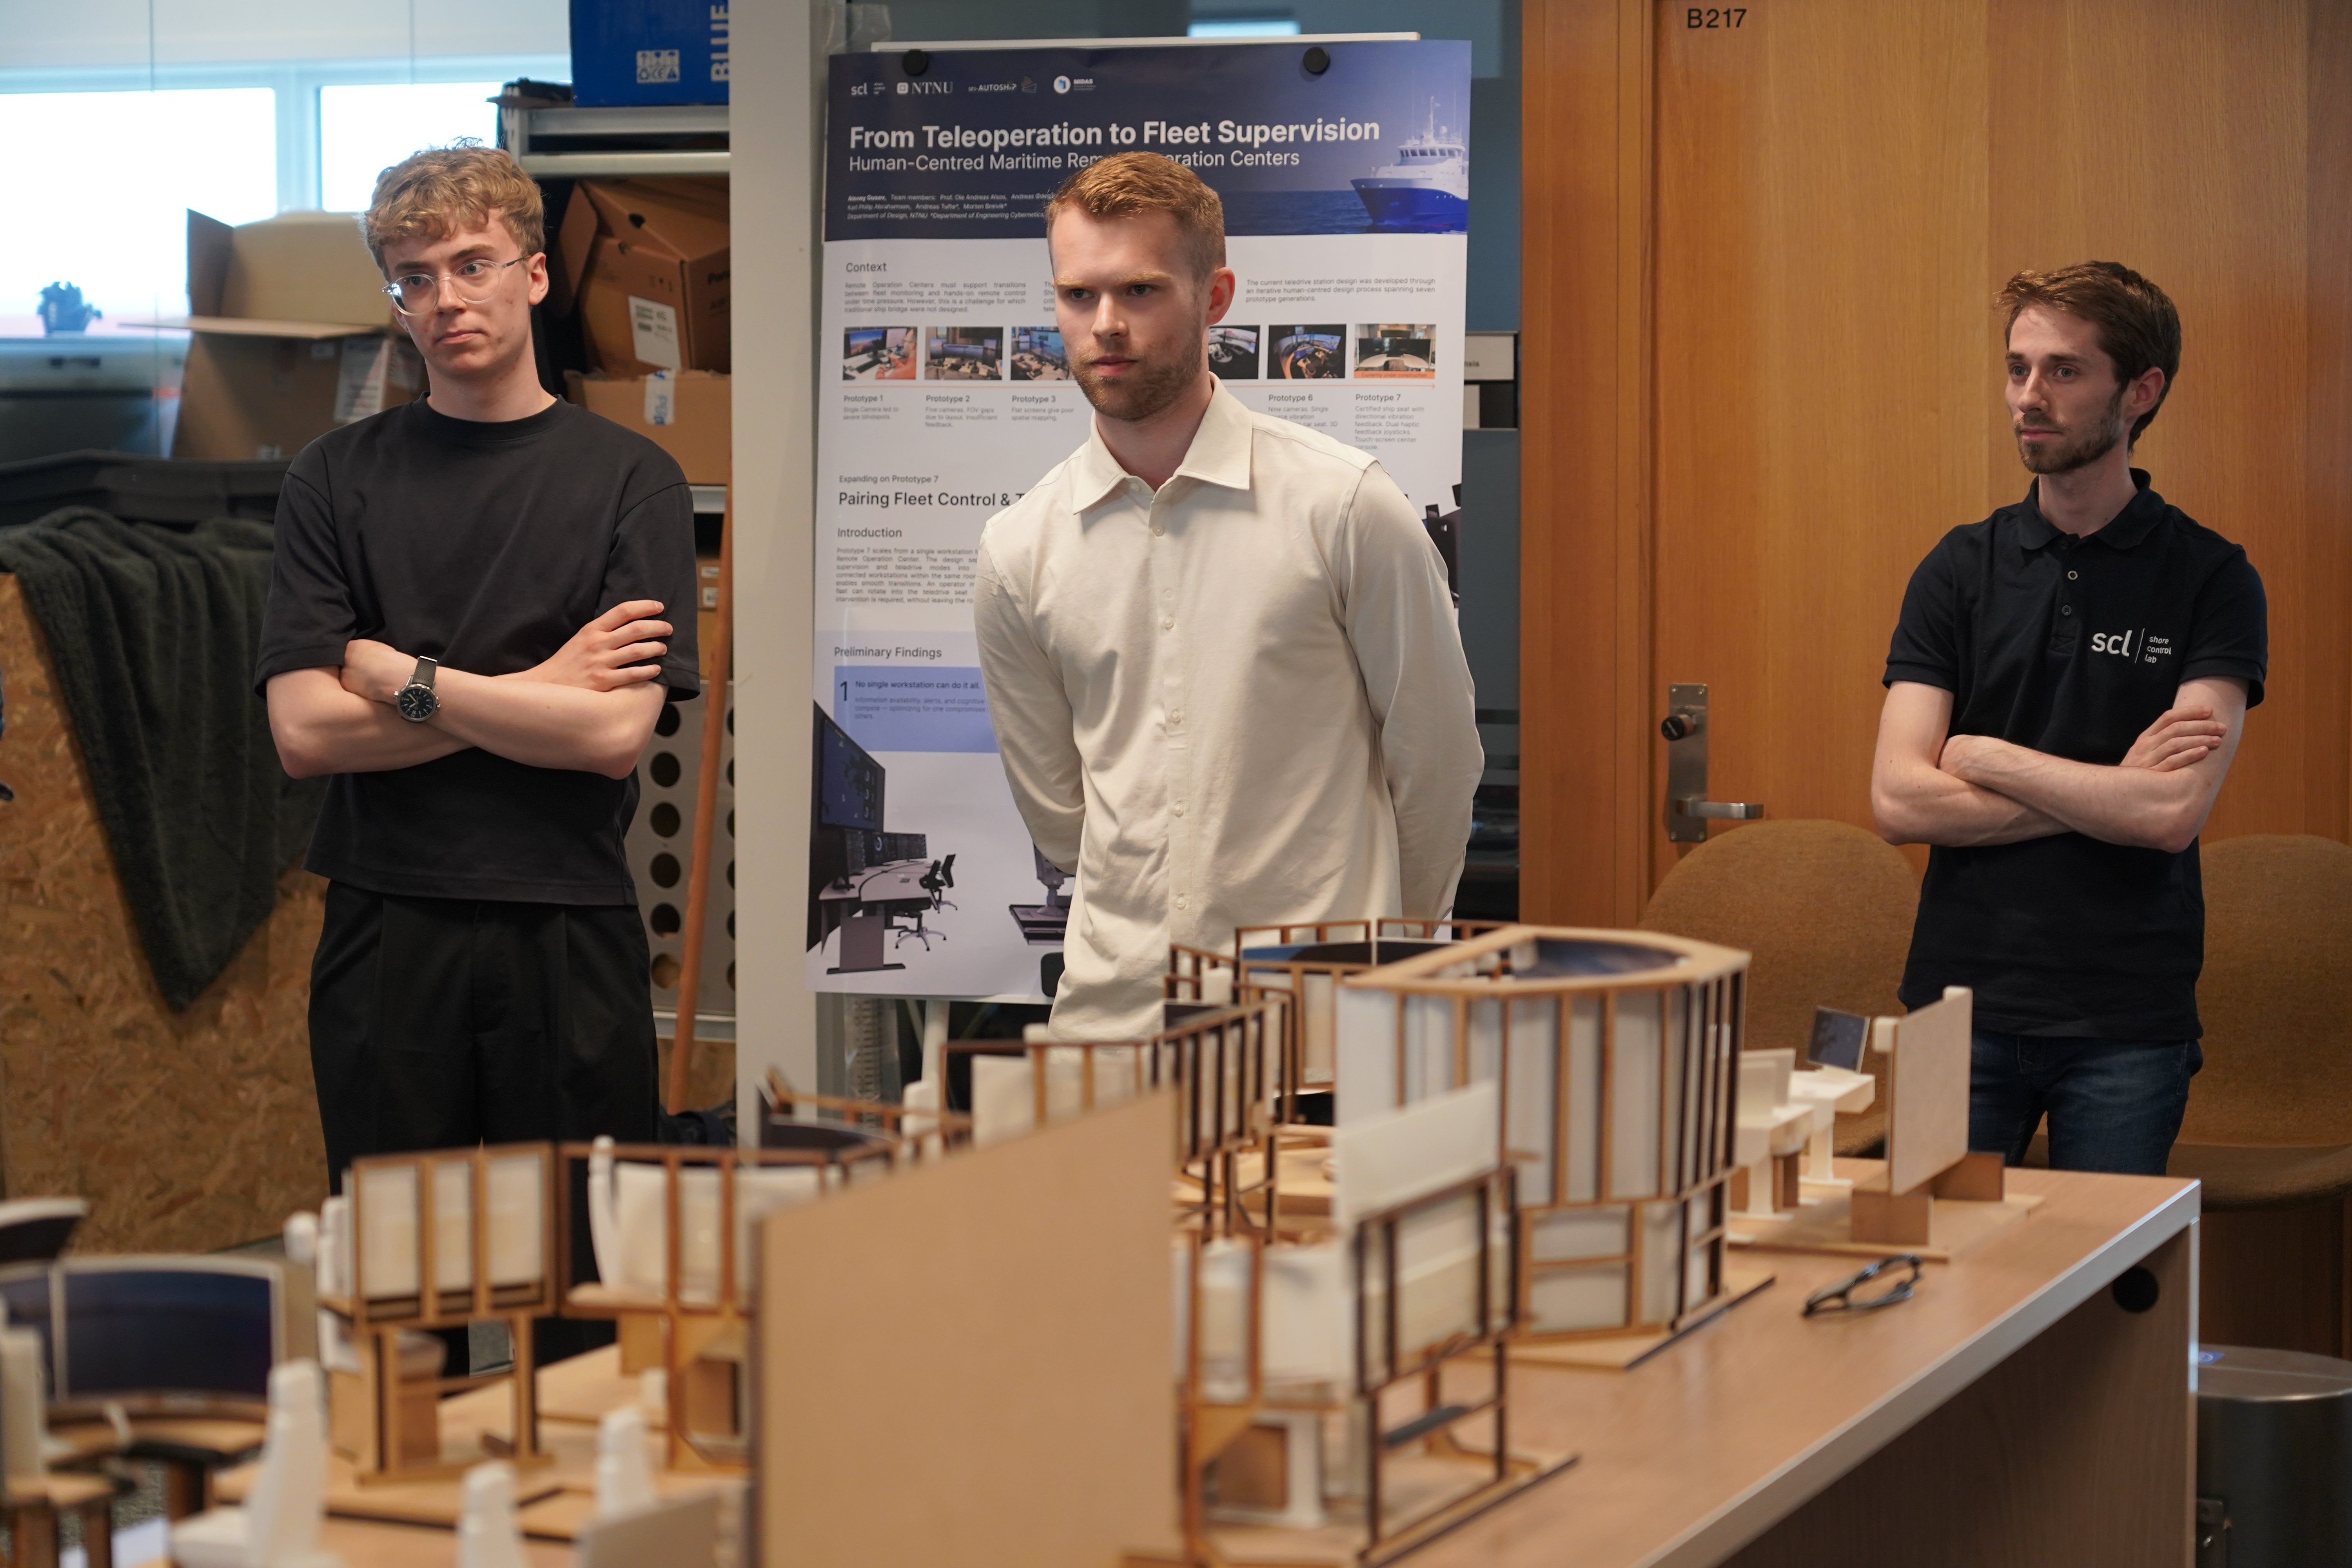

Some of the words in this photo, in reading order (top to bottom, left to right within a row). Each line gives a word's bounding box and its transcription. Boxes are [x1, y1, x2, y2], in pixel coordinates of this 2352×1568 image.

[1688, 8, 1747, 28] B217
[850, 82, 868, 96] scl
[912, 82, 953, 94] NTNU
[850, 126, 915, 149] From
[922, 122, 1103, 152] Teleoperation
[1110, 123, 1136, 145] to
[1143, 121, 1210, 145] Fleet
[1218, 117, 1380, 147] Supervision
[849, 155, 984, 172] Human-Centred
[990, 153, 1062, 170] Maritime
[1230, 150, 1300, 166] Centers
[846, 262, 887, 272] Context
[965, 395, 970, 403] 2
[1011, 395, 1049, 403] Prototype
[1051, 395, 1056, 403] 3
[934, 475, 939, 483] 7
[839, 492, 889, 508] Pairing
[894, 492, 933, 506] Fleet
[938, 492, 996, 506] Control
[1000, 492, 1010, 506] &
[837, 527, 902, 538] Introduction
[2091, 630, 2132, 657] scl
[2149, 635, 2169, 644] shore
[834, 646, 892, 659] Preliminary
[895, 647, 942, 659] Findings
[2147, 646, 2171, 655] control
[2145, 654, 2157, 663] lab
[840, 681, 848, 701] 1
